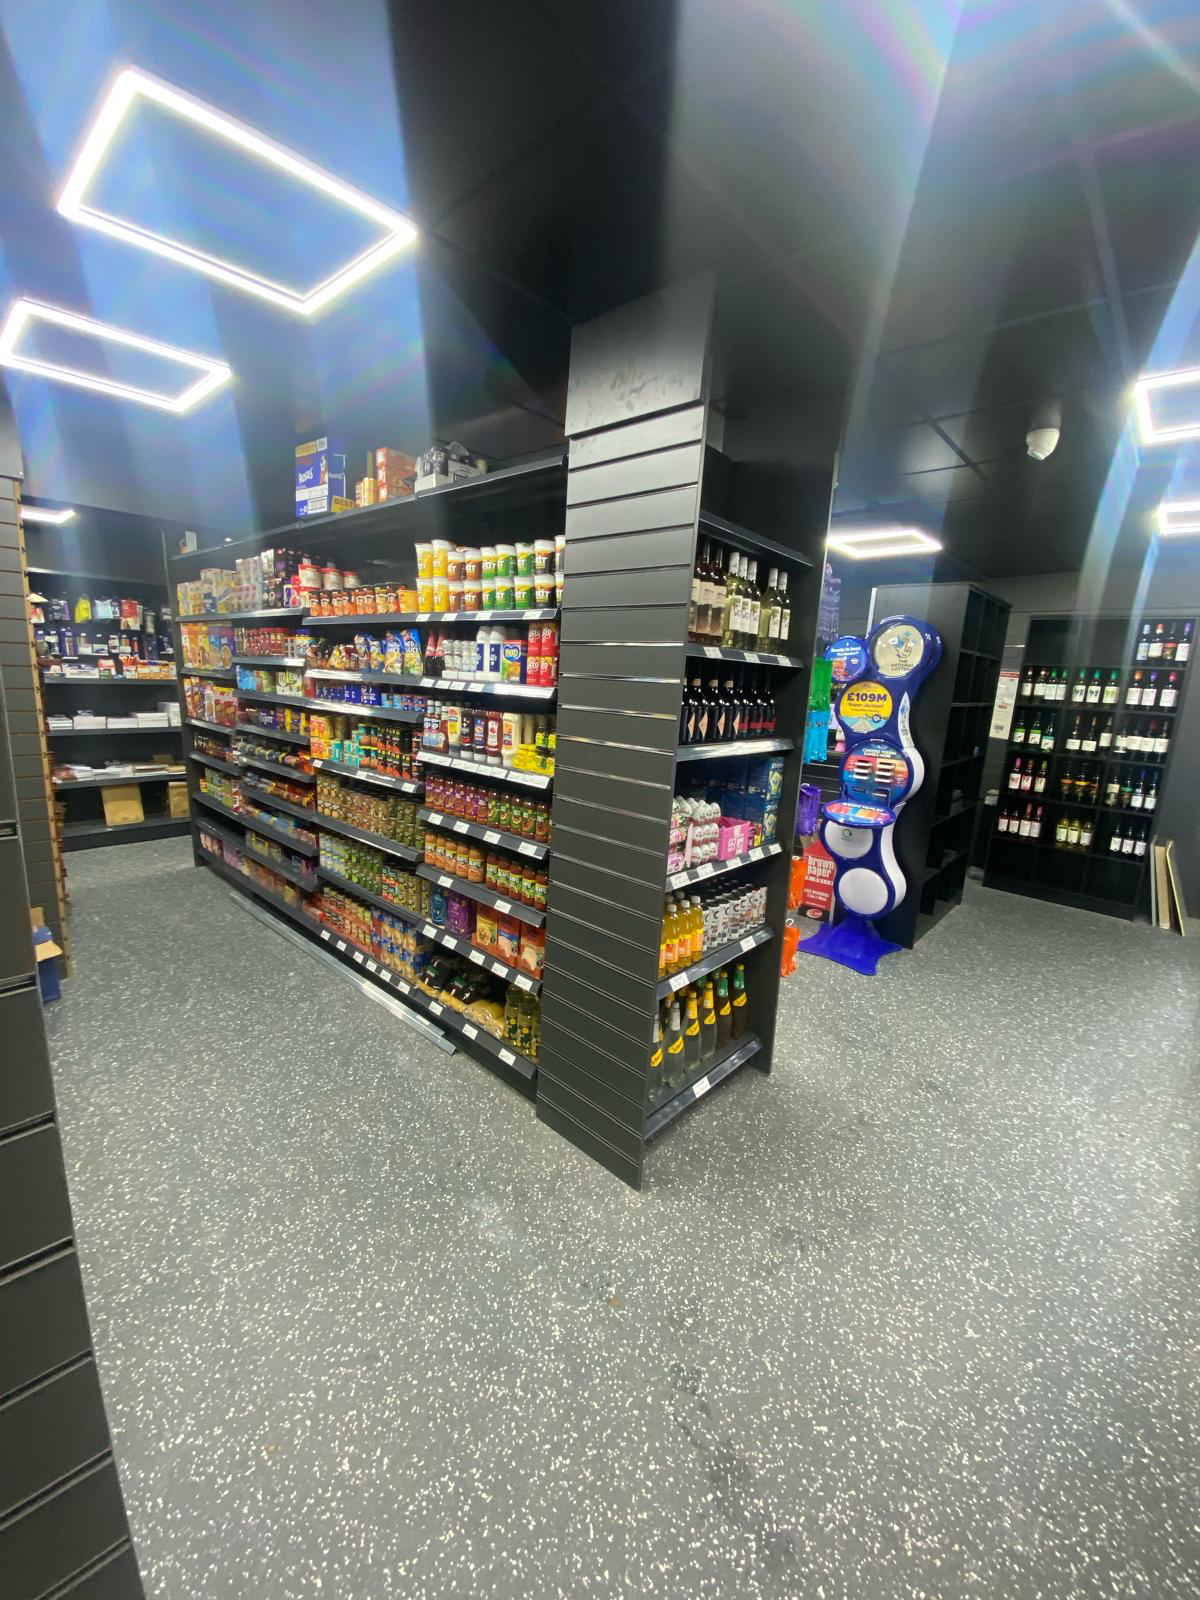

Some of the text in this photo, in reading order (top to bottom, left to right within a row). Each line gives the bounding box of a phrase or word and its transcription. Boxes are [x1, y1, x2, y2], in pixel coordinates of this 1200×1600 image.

[847, 692, 888, 702] £109M
[808, 854, 835, 870] brown
[807, 864, 832, 878] paper
